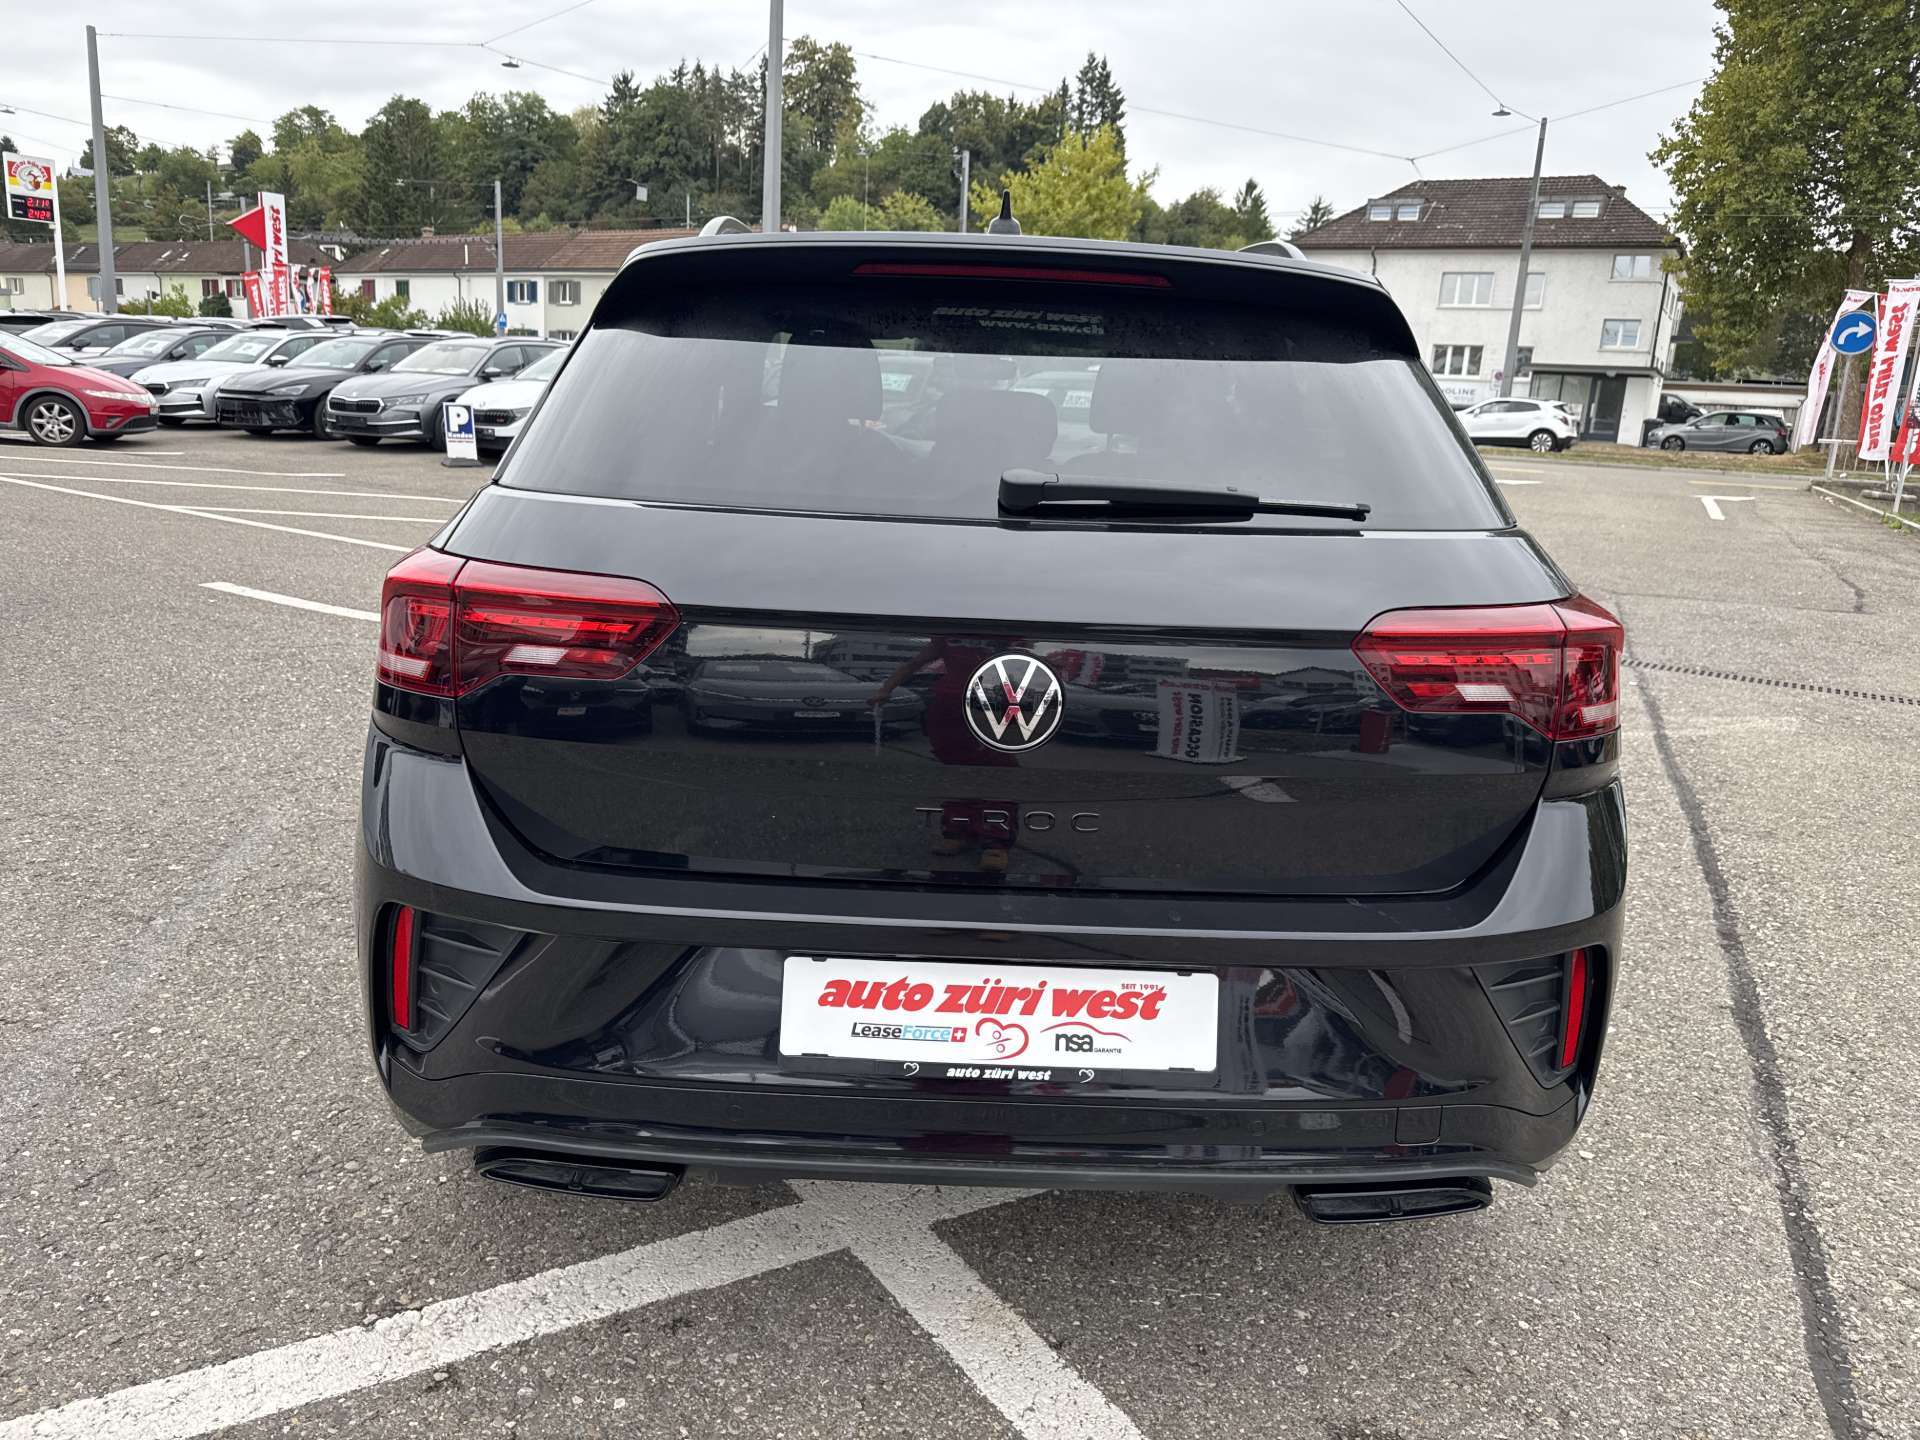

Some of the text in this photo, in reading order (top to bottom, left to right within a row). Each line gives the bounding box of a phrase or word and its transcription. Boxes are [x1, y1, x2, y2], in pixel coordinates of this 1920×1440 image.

[270, 205, 283, 246] west
[933, 307, 989, 316] auto
[1046, 313, 1102, 323] west
[979, 320, 1104, 335] www.azw.ch
[448, 406, 469, 432] P
[915, 806, 1101, 831] T-ROC
[817, 976, 1168, 1021] auto züri west
[851, 1022, 951, 1041] LeaseForce
[1055, 1033, 1094, 1053] nsa
[946, 1067, 1052, 1081] auto züri west
